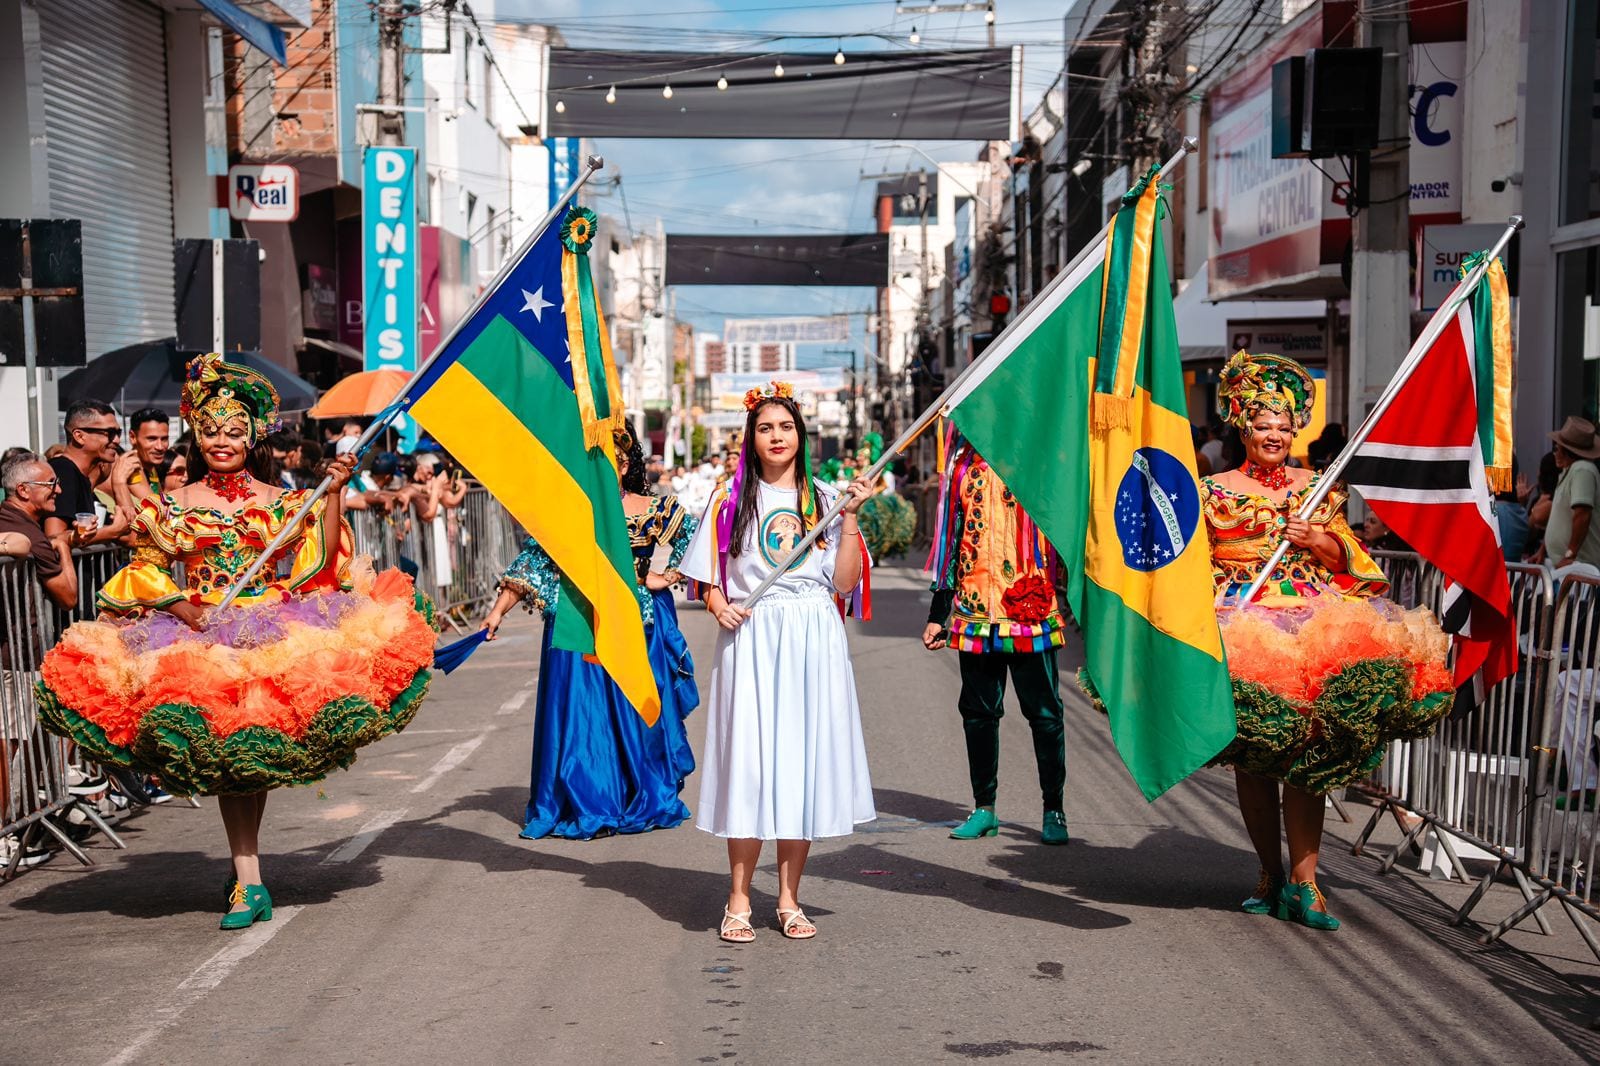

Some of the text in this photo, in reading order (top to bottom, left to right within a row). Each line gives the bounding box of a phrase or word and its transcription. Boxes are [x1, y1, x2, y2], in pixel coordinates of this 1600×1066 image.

[236, 174, 287, 208] Real
[1257, 170, 1314, 237] CENTRAL
[1408, 190, 1450, 200] NTRAL
[1153, 489, 1181, 545] PROGRESSO
